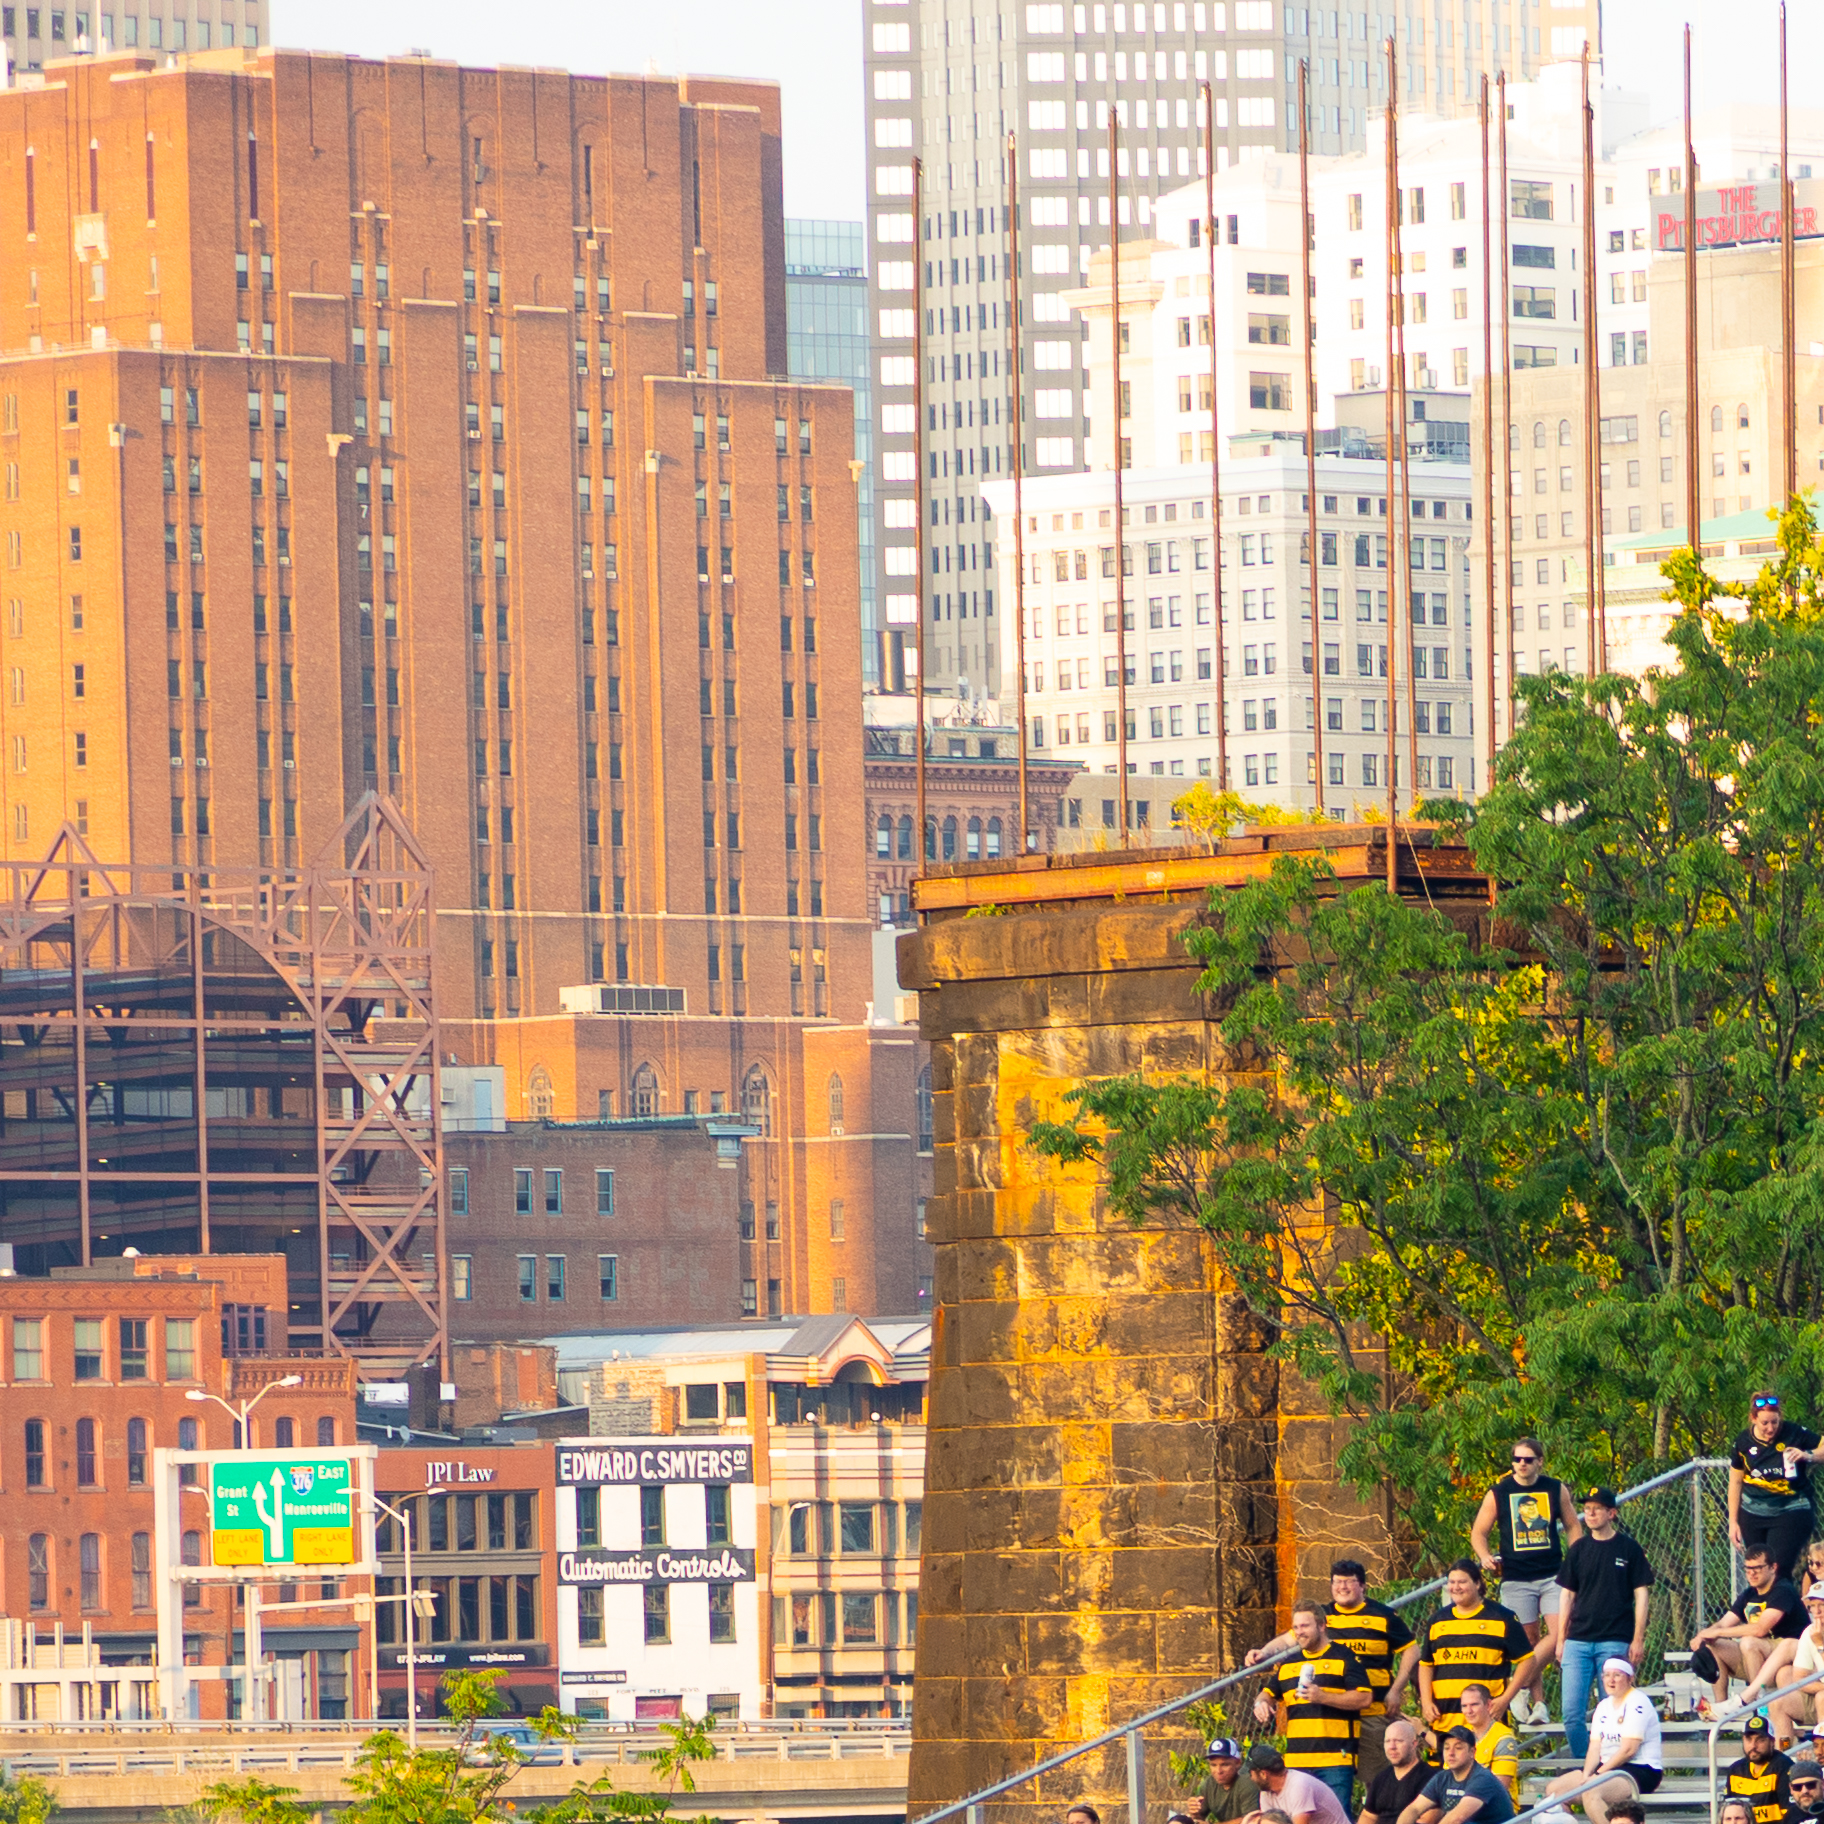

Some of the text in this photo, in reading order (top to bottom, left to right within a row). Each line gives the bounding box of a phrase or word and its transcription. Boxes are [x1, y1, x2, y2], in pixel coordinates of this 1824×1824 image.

[560, 1451, 637, 1480] EDWARD
[425, 1462, 493, 1486] JPI Law
[294, 1474, 310, 1489] 376
[217, 1486, 248, 1498] Grant
[227, 1504, 239, 1516] St
[284, 1503, 348, 1515] Monroeville
[217, 1534, 259, 1543] LEFT LANE
[300, 1533, 347, 1542] RIGHT LANE
[228, 1549, 248, 1558] ONLY
[313, 1548, 334, 1556] ONLY
[560, 1550, 746, 1580] Automatic Controls
[1454, 1650, 1477, 1661] AHN
